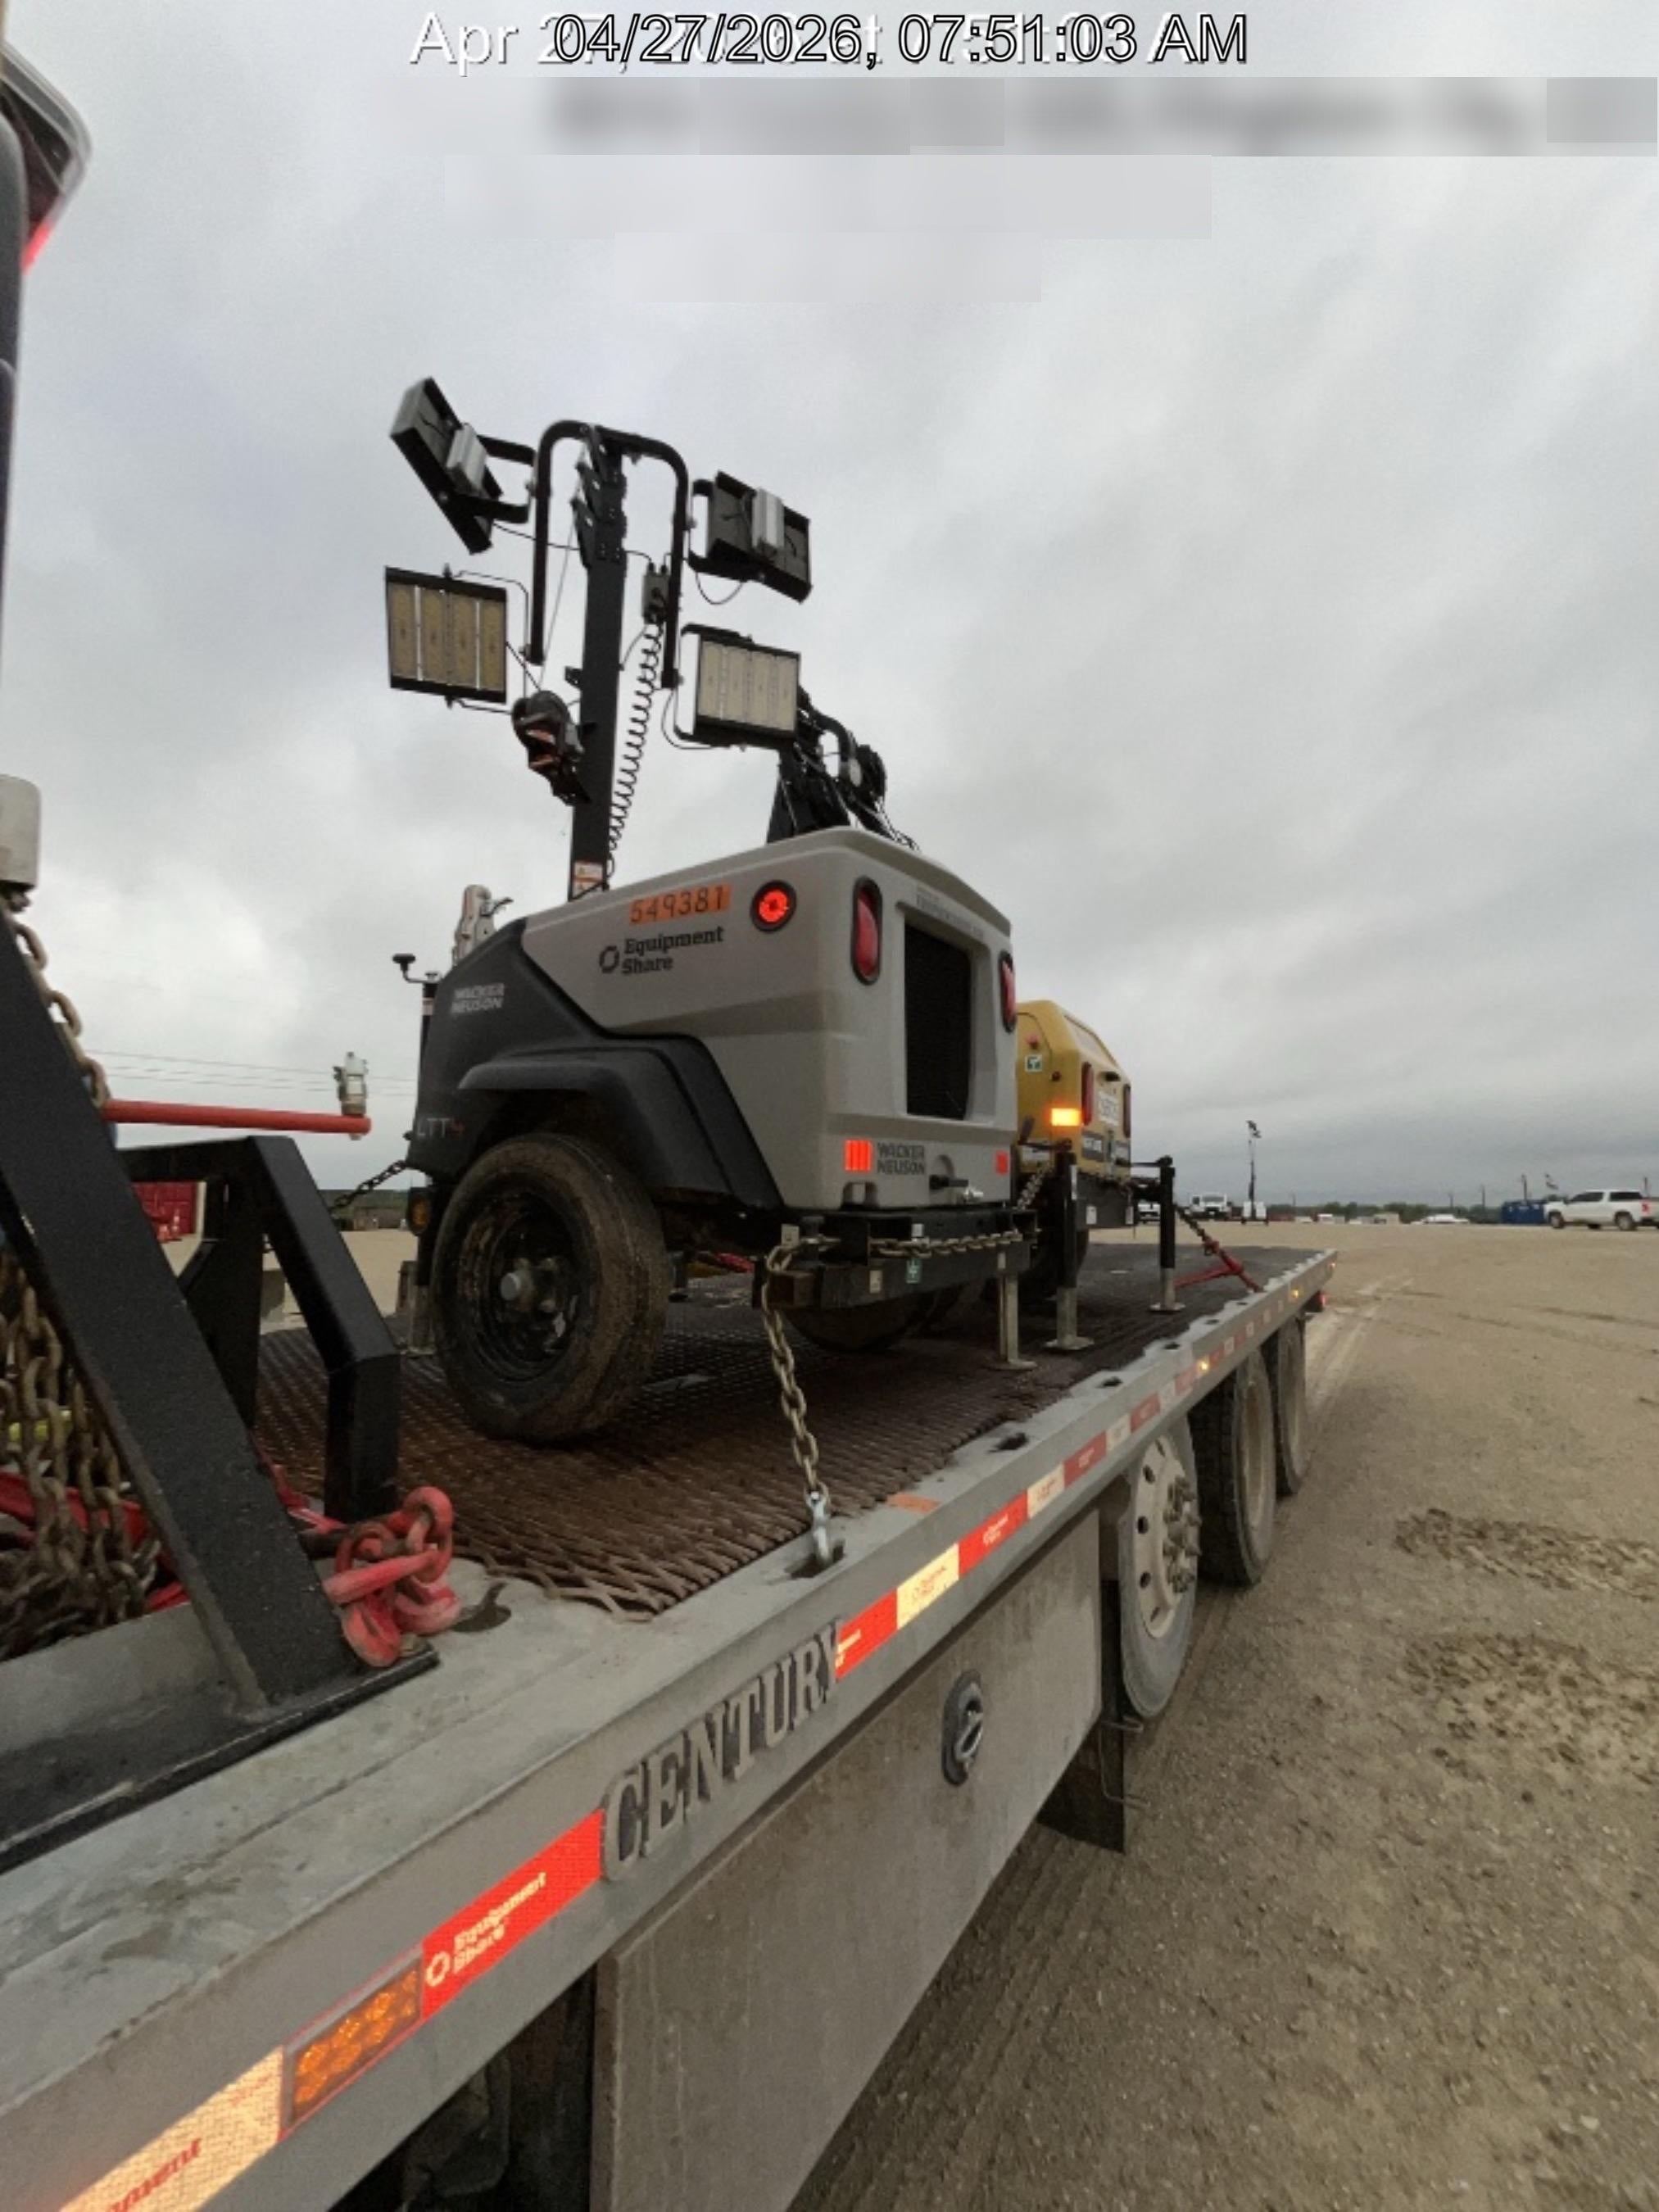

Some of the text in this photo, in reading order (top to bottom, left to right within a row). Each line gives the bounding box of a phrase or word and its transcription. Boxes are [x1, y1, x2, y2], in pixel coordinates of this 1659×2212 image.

[629, 886, 725, 923] 549381
[623, 926, 724, 956] Equipment
[620, 955, 674, 976] Share
[603, 1616, 843, 1882] CENTURY
